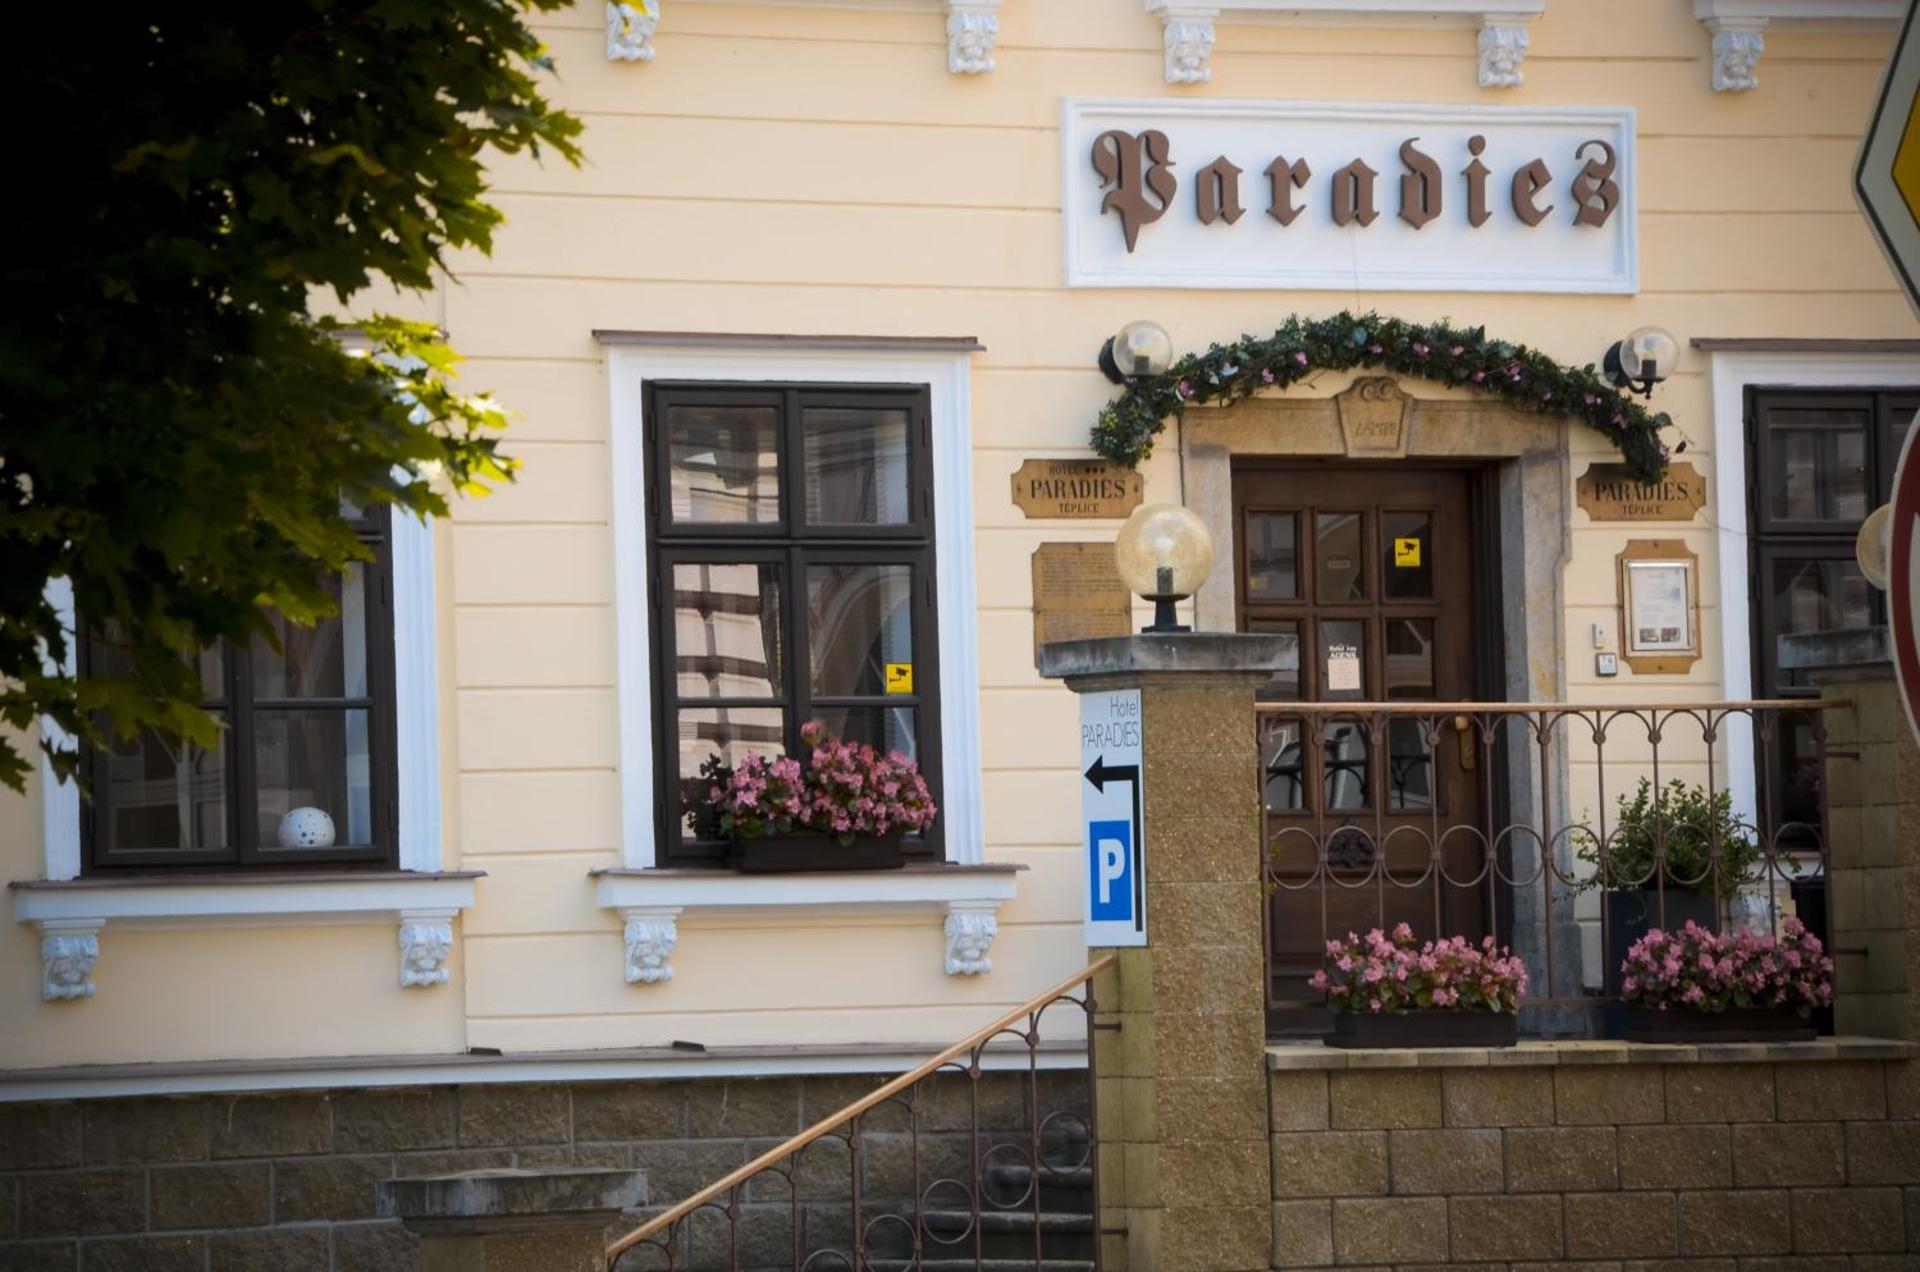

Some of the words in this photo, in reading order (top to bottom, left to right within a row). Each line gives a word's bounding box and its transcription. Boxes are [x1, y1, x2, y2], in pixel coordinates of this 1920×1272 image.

[1091, 128, 1621, 254] Paradies
[1030, 479, 1126, 499] PARADIES
[1594, 480, 1689, 501] PARADIES
[1059, 502, 1100, 513] TEPLICE
[1110, 695, 1139, 717] Hotel
[1098, 838, 1126, 904] P
